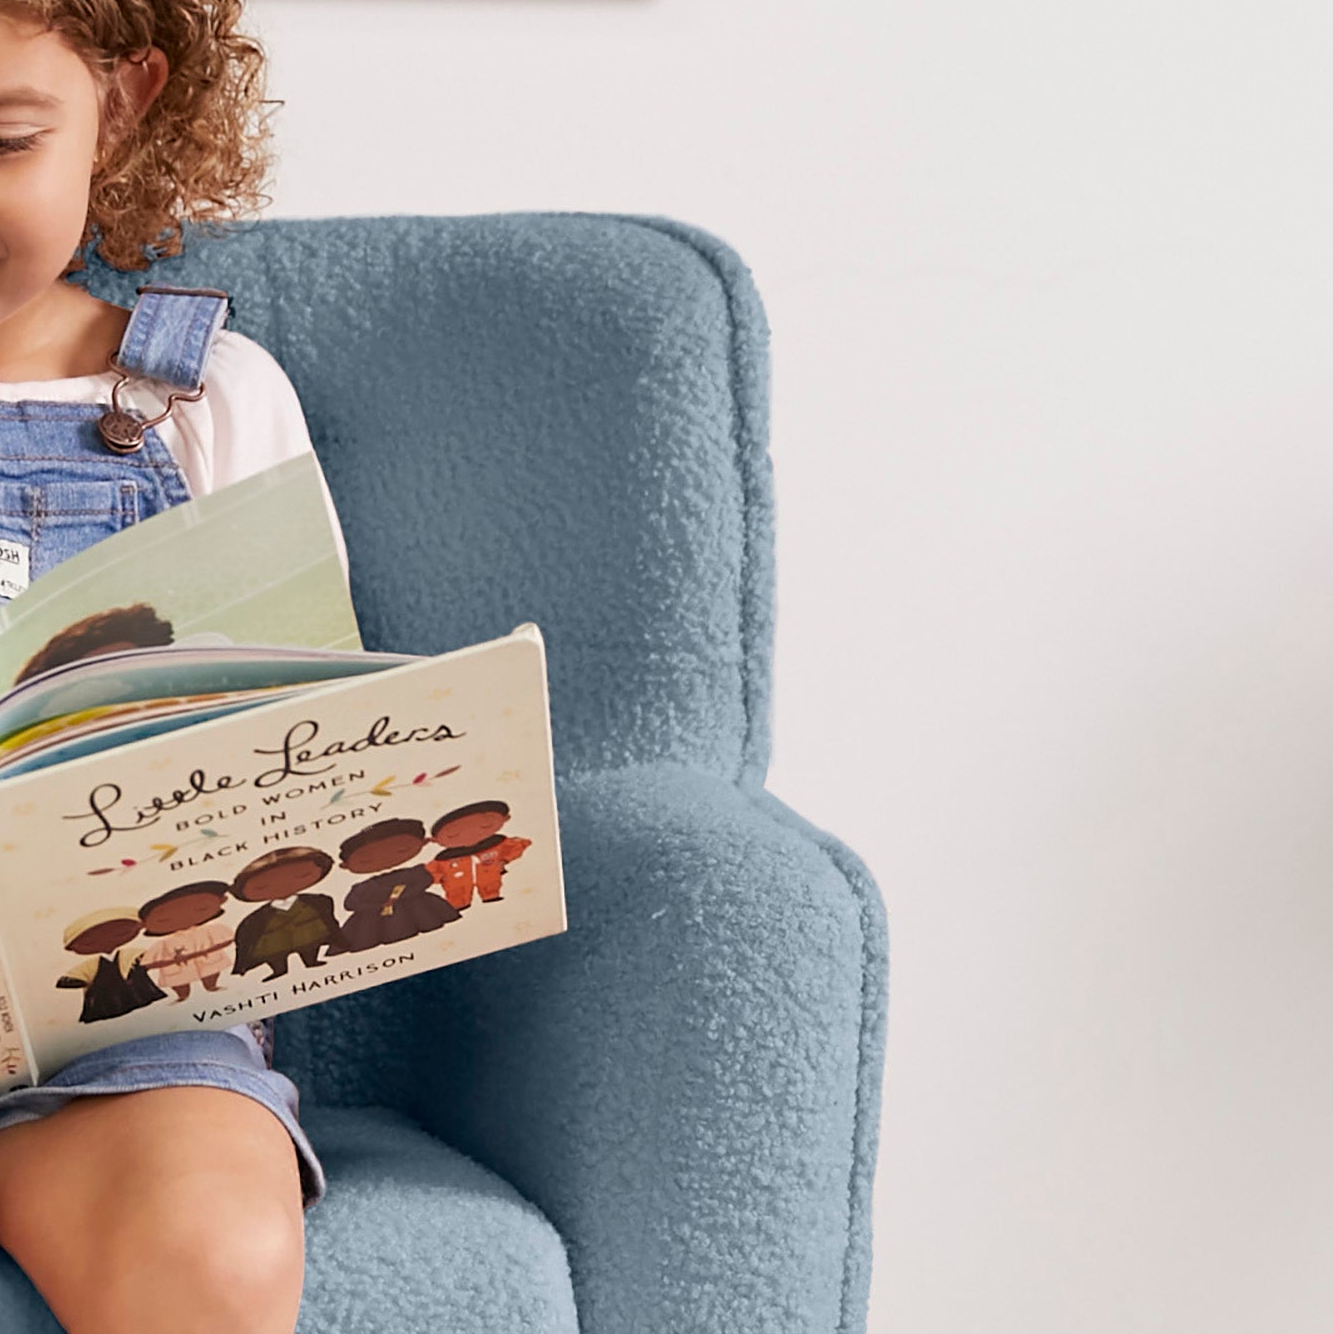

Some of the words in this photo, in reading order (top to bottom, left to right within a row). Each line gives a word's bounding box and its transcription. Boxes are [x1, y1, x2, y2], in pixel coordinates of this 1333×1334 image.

[61, 768, 250, 849] Little
[253, 715, 467, 790] Leaders
[175, 803, 248, 834] BOLD
[262, 768, 368, 809] WOMEN
[169, 841, 250, 872] BLACK
[262, 801, 385, 845] HISTORY
[259, 810, 288, 828] IN
[192, 990, 280, 1025] VASHTI
[292, 951, 417, 997] HARRISON
